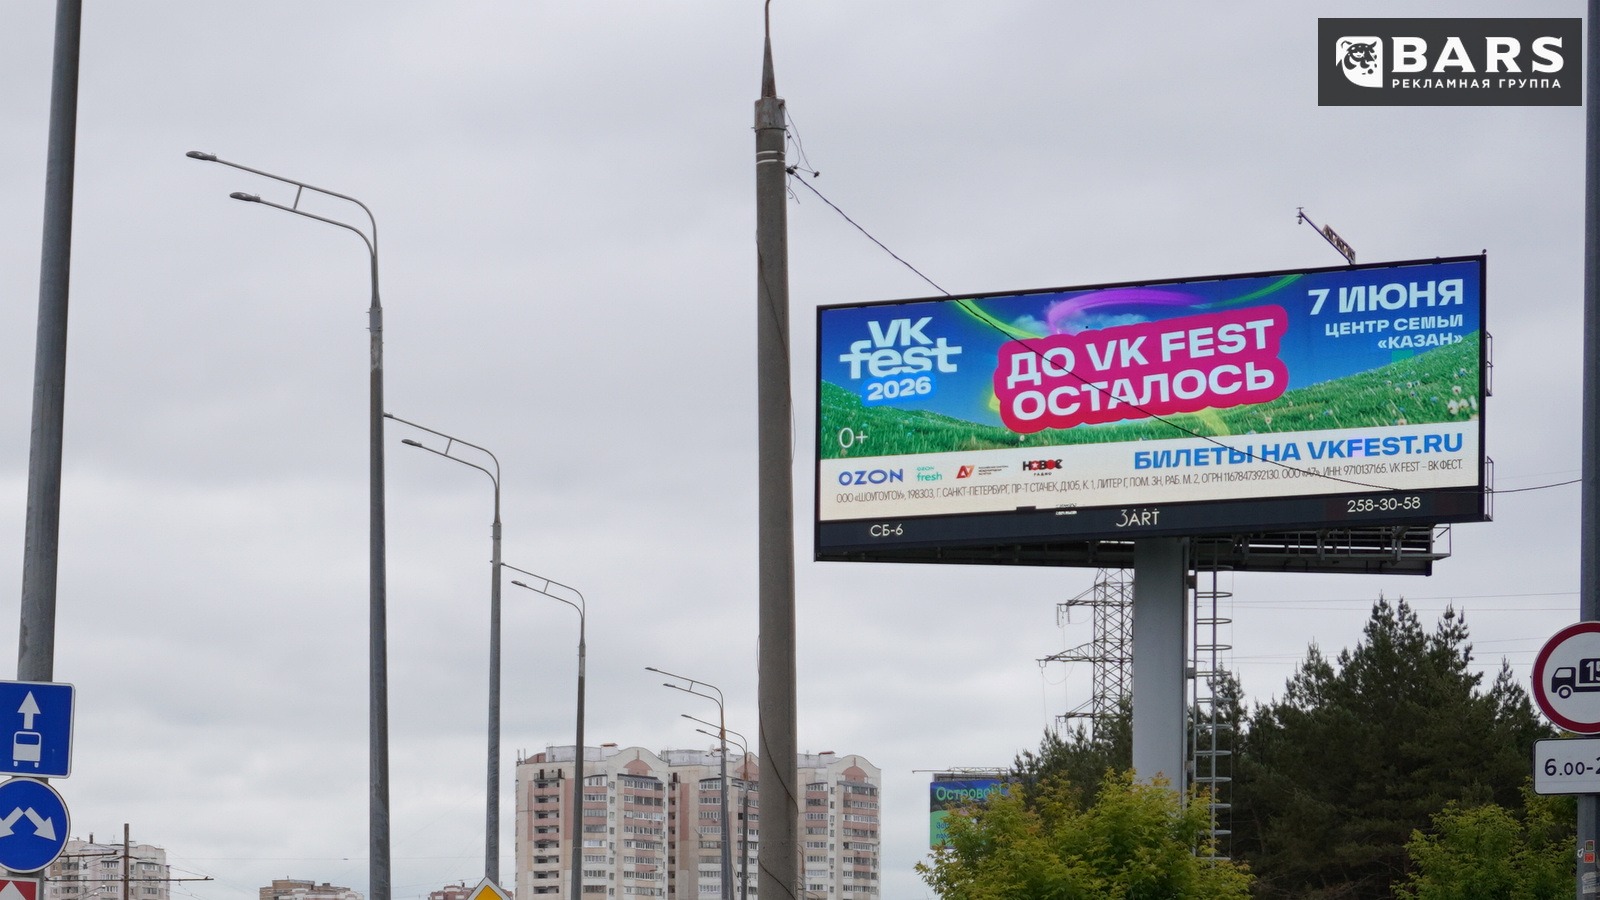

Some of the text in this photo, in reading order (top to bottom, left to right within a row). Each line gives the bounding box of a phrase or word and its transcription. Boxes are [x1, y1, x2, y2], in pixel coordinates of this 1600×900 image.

[1308, 278, 1464, 315] 7 ИЮНЯ
[867, 316, 933, 348] VK
[1325, 314, 1463, 338] ЦЕНТР СЕМЬИ
[1377, 332, 1464, 349] «КАЗАН»
[839, 337, 963, 380] fest
[1006, 318, 1274, 389] ДО VK FEST
[867, 376, 932, 401] 2026
[1012, 361, 1275, 421] ОСТАЛОСЬ
[838, 427, 868, 448] 0+
[1134, 433, 1463, 470] БИЛЕТЫ НА VKFEST.RU
[836, 492, 854, 504] ООО
[1096, 477, 1122, 490] ЛИТЕР
[1201, 472, 1223, 484] ОГРН
[1281, 468, 1301, 479] ООО
[838, 468, 904, 486] OZON
[916, 471, 943, 482] fresh
[1347, 496, 1421, 513] 258-30-58
[870, 523, 904, 537] СБ-6
